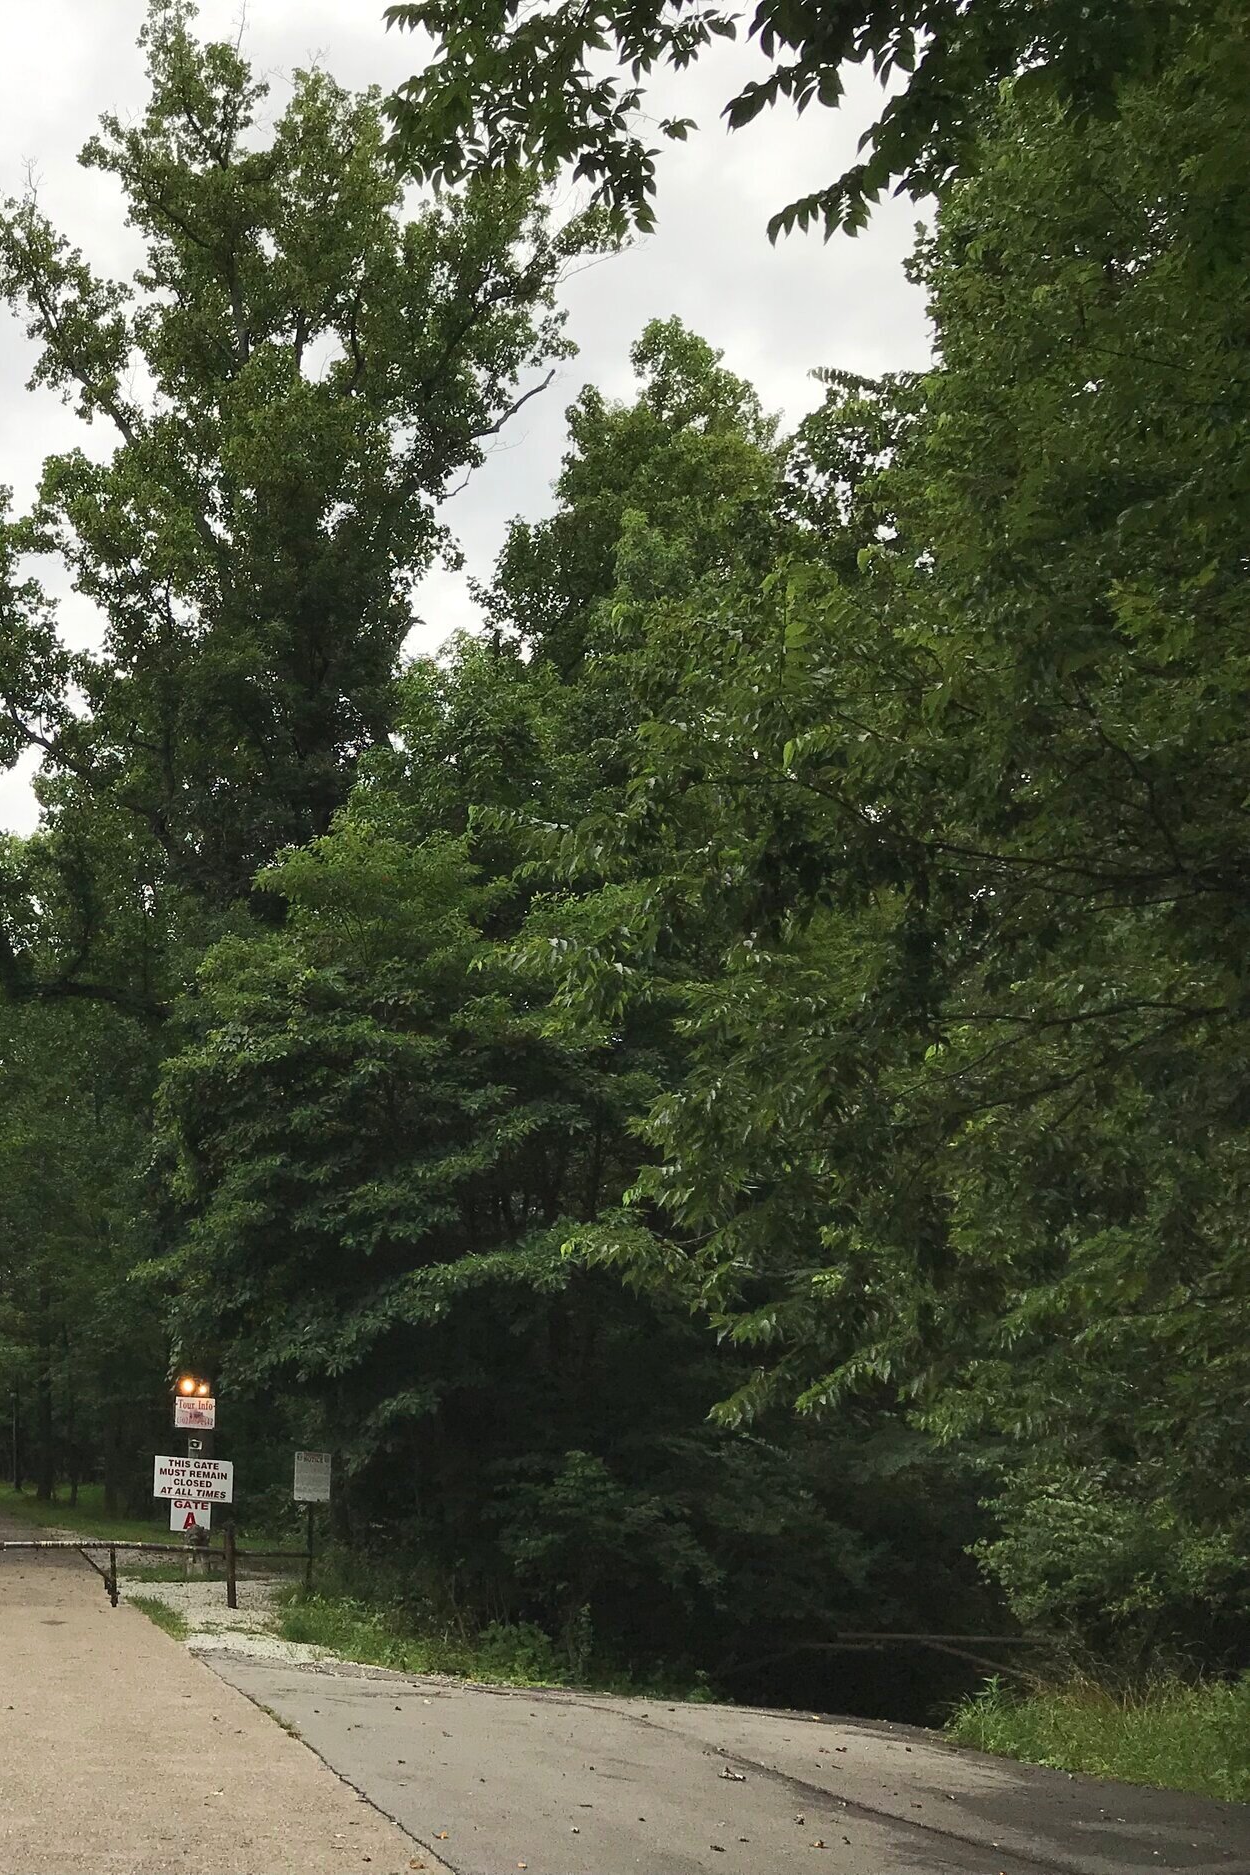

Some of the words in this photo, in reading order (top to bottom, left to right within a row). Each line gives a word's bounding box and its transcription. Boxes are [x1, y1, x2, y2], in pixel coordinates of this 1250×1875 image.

[178, 1399, 195, 1409] Tour
[198, 1400, 213, 1411] Info
[168, 1459, 191, 1468] THIS
[194, 1461, 220, 1470] GATE
[159, 1468, 186, 1477] MUST
[190, 1470, 228, 1480] REMAIN
[173, 1478, 213, 1488] CLOSED
[160, 1486, 173, 1494] AT
[175, 1487, 193, 1496] ALL
[196, 1489, 227, 1499] TIMES
[173, 1500, 209, 1511] GATE
[183, 1511, 197, 1530] A
